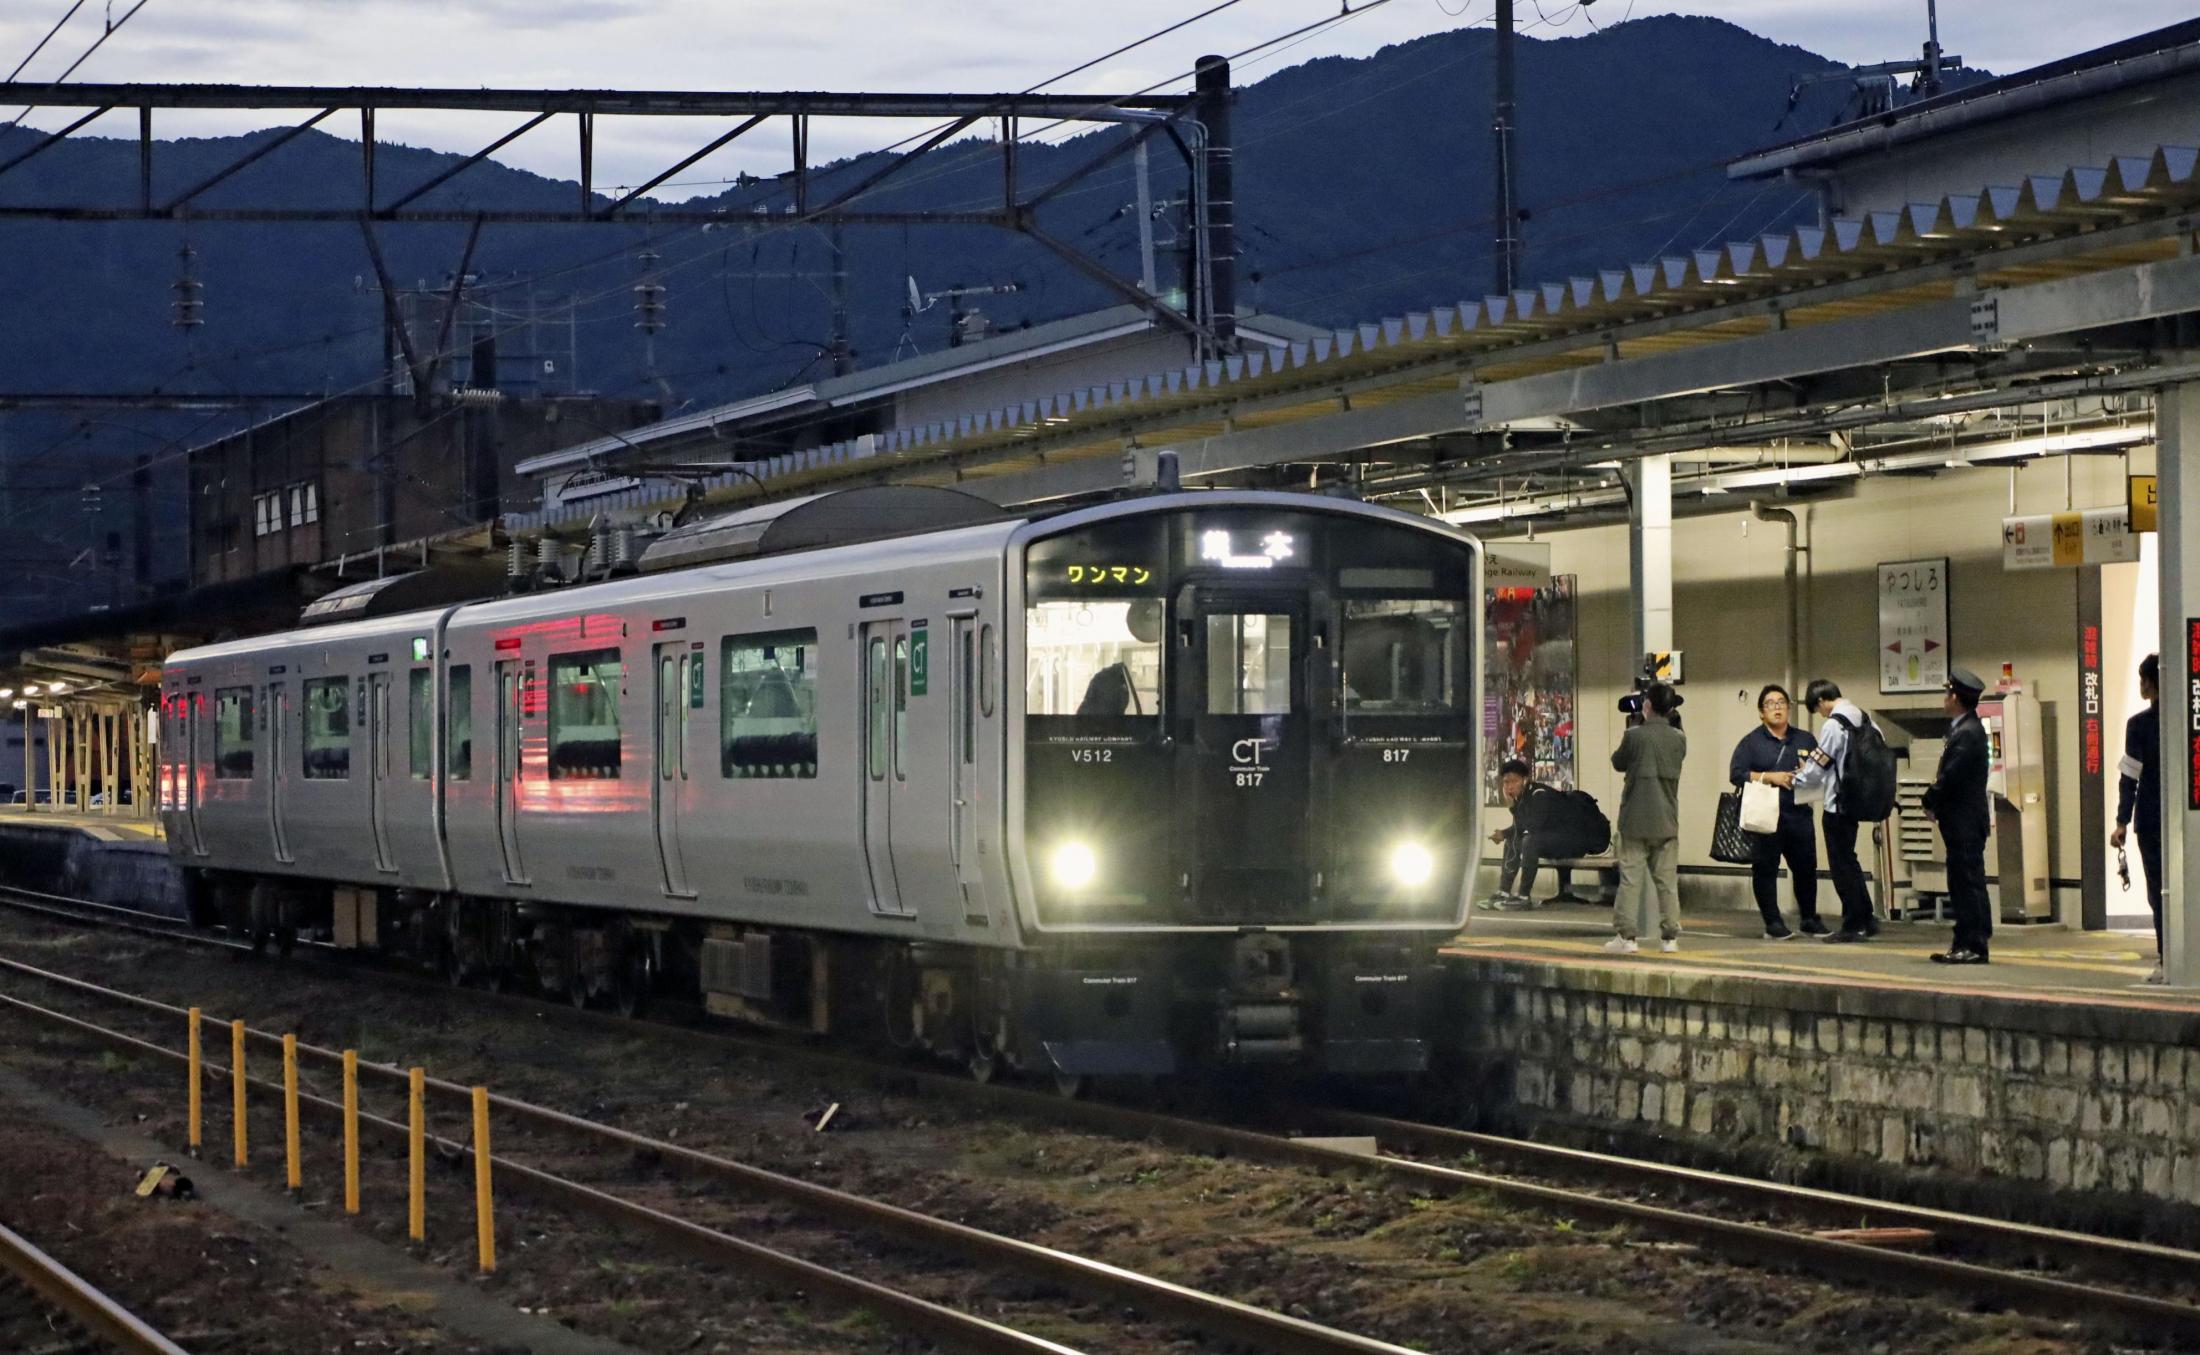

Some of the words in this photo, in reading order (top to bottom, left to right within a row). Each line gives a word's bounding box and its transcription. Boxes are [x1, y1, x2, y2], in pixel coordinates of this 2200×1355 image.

[1203, 530, 1293, 560] 本
[1068, 566, 1150, 584] ワンマン
[1501, 567, 1536, 578] Railway
[1886, 568, 1938, 592] やつしろ
[2085, 672, 2099, 714] 改札口
[1071, 749, 1112, 762] V512
[1232, 738, 1267, 764] CT
[1383, 749, 1410, 762] 817
[1236, 773, 1263, 786] 817
